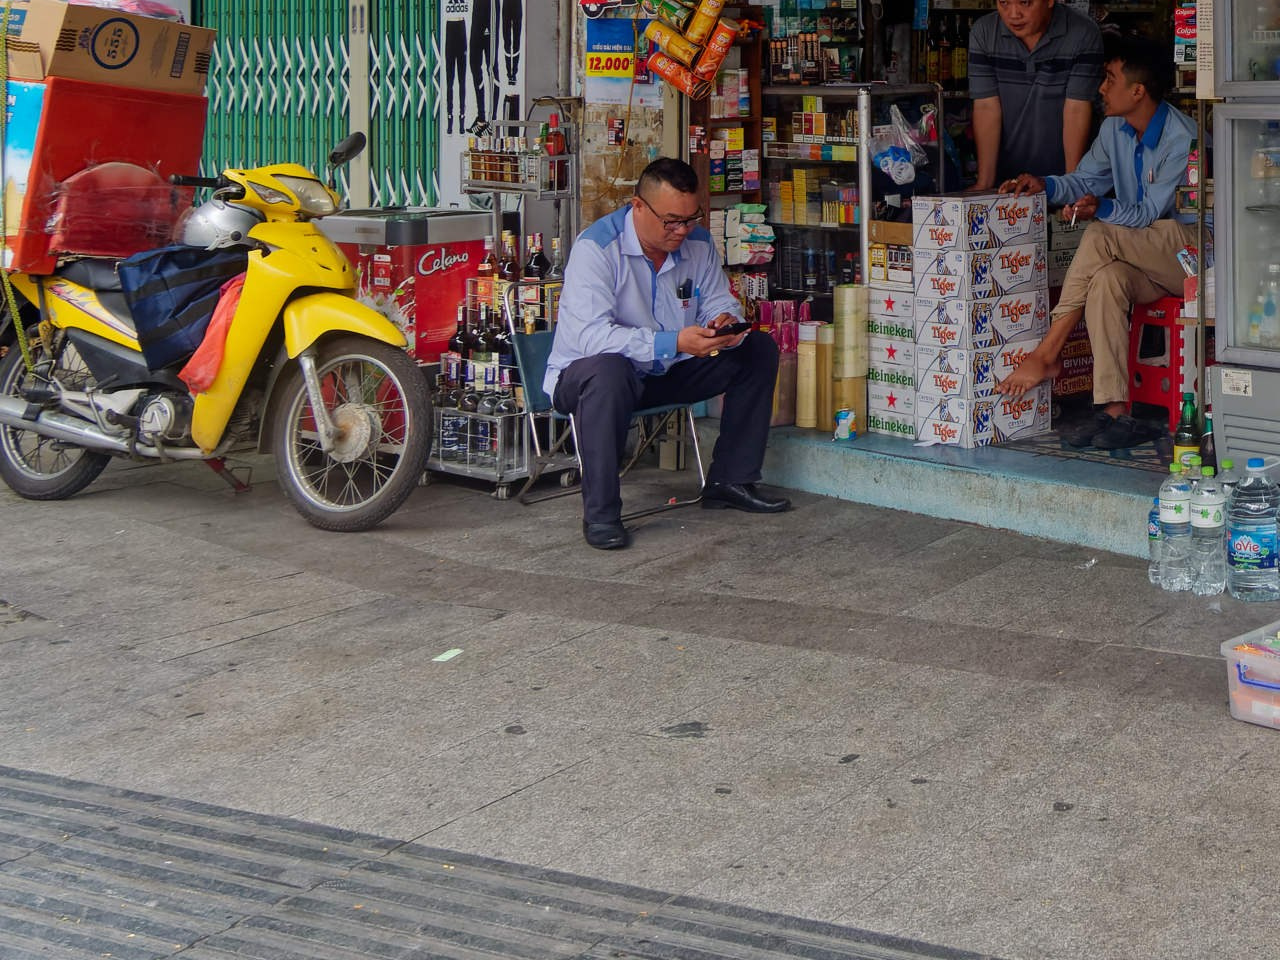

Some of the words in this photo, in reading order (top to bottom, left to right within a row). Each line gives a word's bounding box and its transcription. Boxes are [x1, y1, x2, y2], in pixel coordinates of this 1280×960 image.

[446, 3, 469, 14] adidas
[588, 56, 630, 72] 12.000
[996, 200, 1031, 226] Tiger
[928, 228, 954, 247] Tiger
[417, 247, 469, 277] Celano
[999, 250, 1032, 276] Tiger
[930, 276, 957, 297] Tiger
[999, 299, 1033, 325] Tiger
[868, 319, 914, 340] Heineken
[931, 325, 957, 345] Tiger
[868, 367, 915, 388] Heineken
[933, 374, 958, 394] Tiger
[1000, 397, 1036, 423] Tiger
[869, 415, 915, 436] Heineken
[932, 423, 959, 444] Tiger
